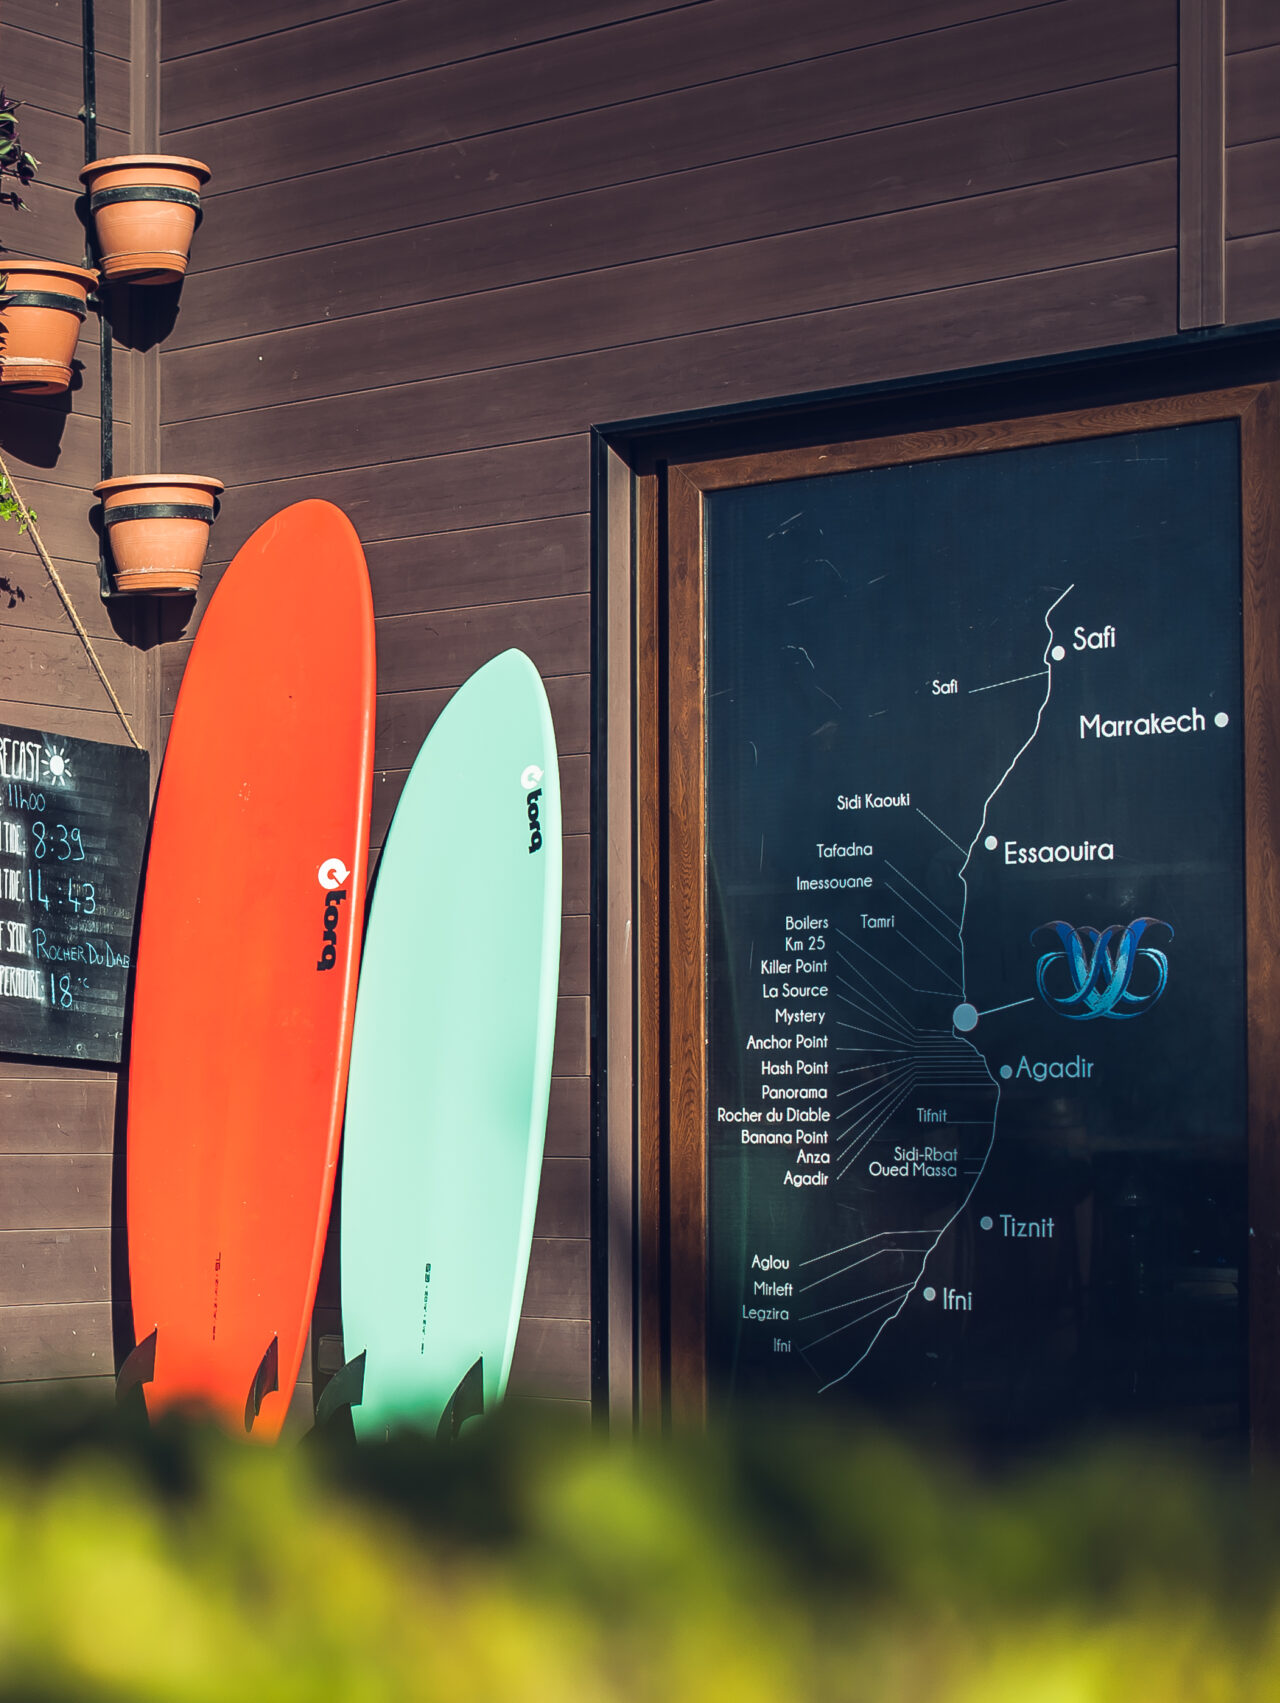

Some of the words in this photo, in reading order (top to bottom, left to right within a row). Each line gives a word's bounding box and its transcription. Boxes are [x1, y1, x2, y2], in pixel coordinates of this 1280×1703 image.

[1072, 625, 1116, 651] Safi
[931, 678, 958, 696] Safi
[1079, 706, 1206, 739] Marrakech
[836, 794, 862, 811] Sidi
[864, 792, 910, 809] Kaouki
[816, 841, 873, 858] Tafadna
[1004, 840, 1114, 865] Essaouira
[796, 875, 873, 891] Imessouane
[785, 915, 829, 931] Boilers
[859, 913, 895, 929] Tamri
[785, 936, 804, 952] Km
[808, 935, 826, 951] 25
[760, 959, 792, 975] Killer
[795, 958, 828, 974] Point
[762, 983, 779, 999] La
[781, 982, 829, 998] Source
[775, 1008, 826, 1026] Mystery
[746, 1034, 793, 1050] Anchor
[796, 1033, 829, 1049] Point
[761, 1060, 793, 1075] Hash
[796, 1059, 829, 1075] Point
[1015, 1054, 1095, 1082] Agadir
[761, 1084, 828, 1100] Panorama
[717, 1107, 763, 1123] Rocher
[765, 1107, 784, 1123] du
[786, 1106, 831, 1122] Diable
[916, 1106, 950, 1124] Tifnit
[741, 1129, 793, 1145] Banana
[795, 1129, 829, 1145] Point
[796, 1148, 831, 1164] Anza
[893, 1146, 958, 1162] Sidi-Rbat
[868, 1161, 909, 1177] Oued
[912, 1161, 957, 1177] Massa
[783, 1170, 829, 1188] Agadir
[999, 1214, 1055, 1238] Tiznit
[751, 1254, 790, 1271] Aglou
[753, 1280, 794, 1297] Mirleft
[943, 1287, 972, 1311] Ifni
[742, 1304, 790, 1322] Legzira
[773, 1337, 791, 1353] Ifni
